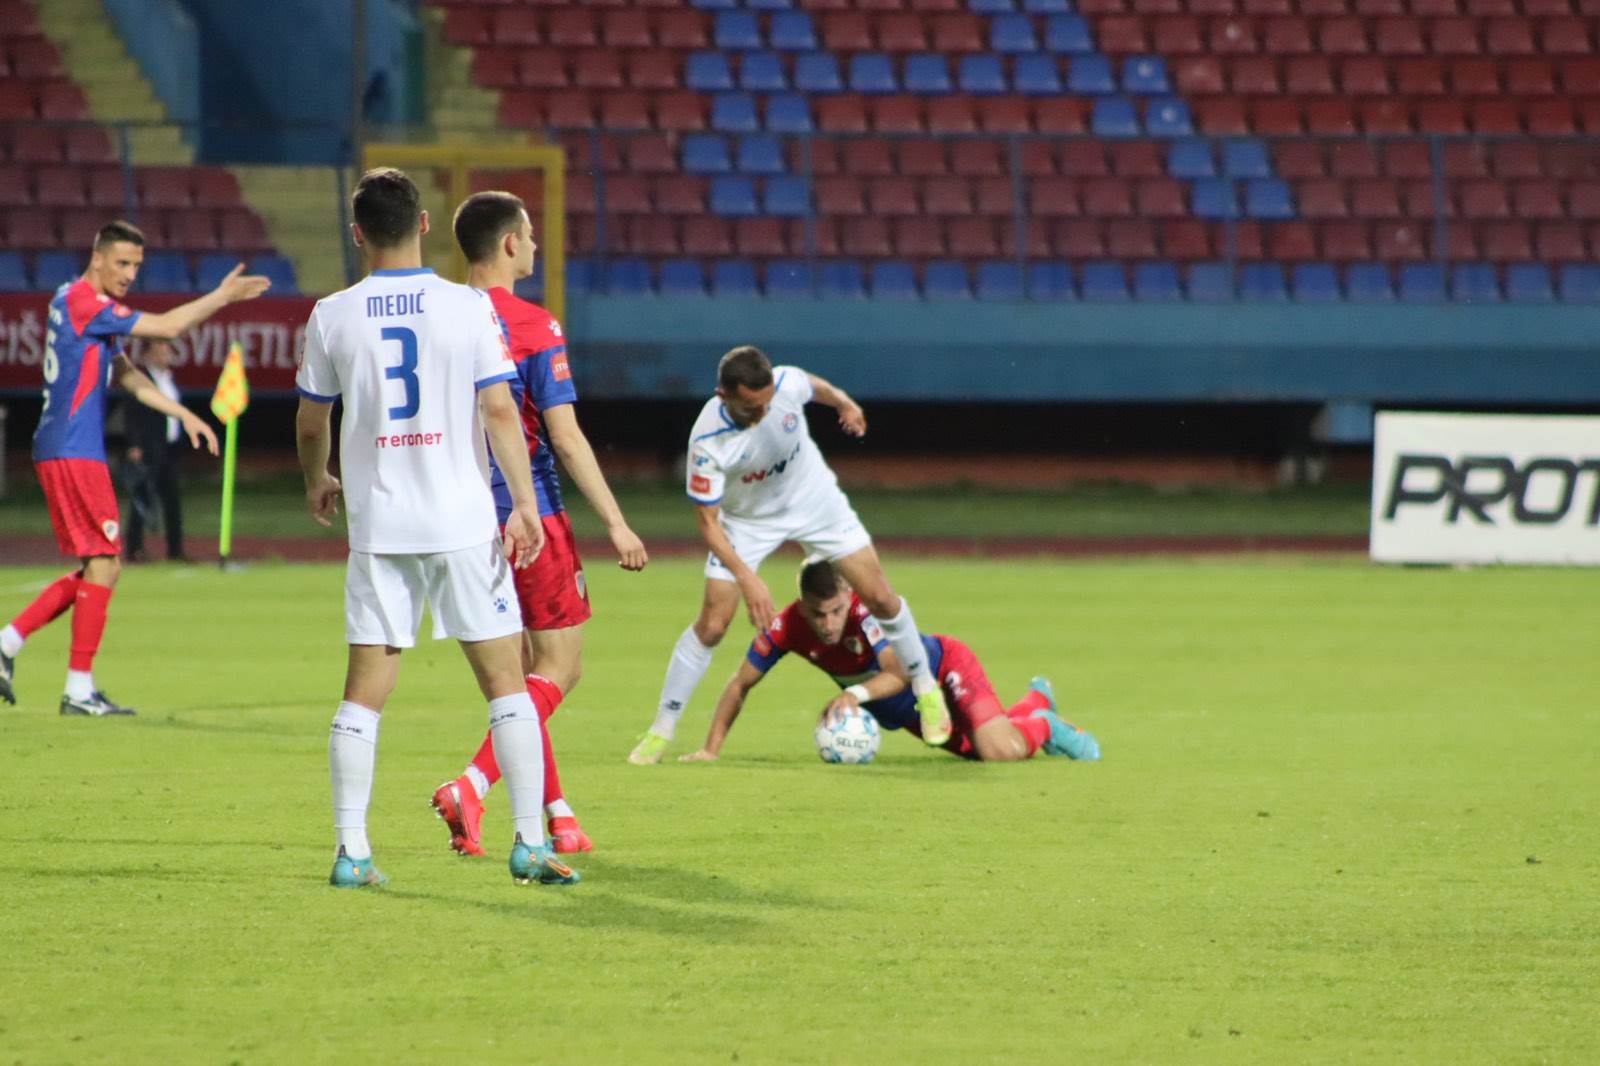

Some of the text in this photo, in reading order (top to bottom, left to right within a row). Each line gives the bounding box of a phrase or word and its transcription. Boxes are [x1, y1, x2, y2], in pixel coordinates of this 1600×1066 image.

[366, 289, 425, 318] MEDIĆ
[380, 326, 421, 421] 3
[835, 736, 869, 750] SELECT
